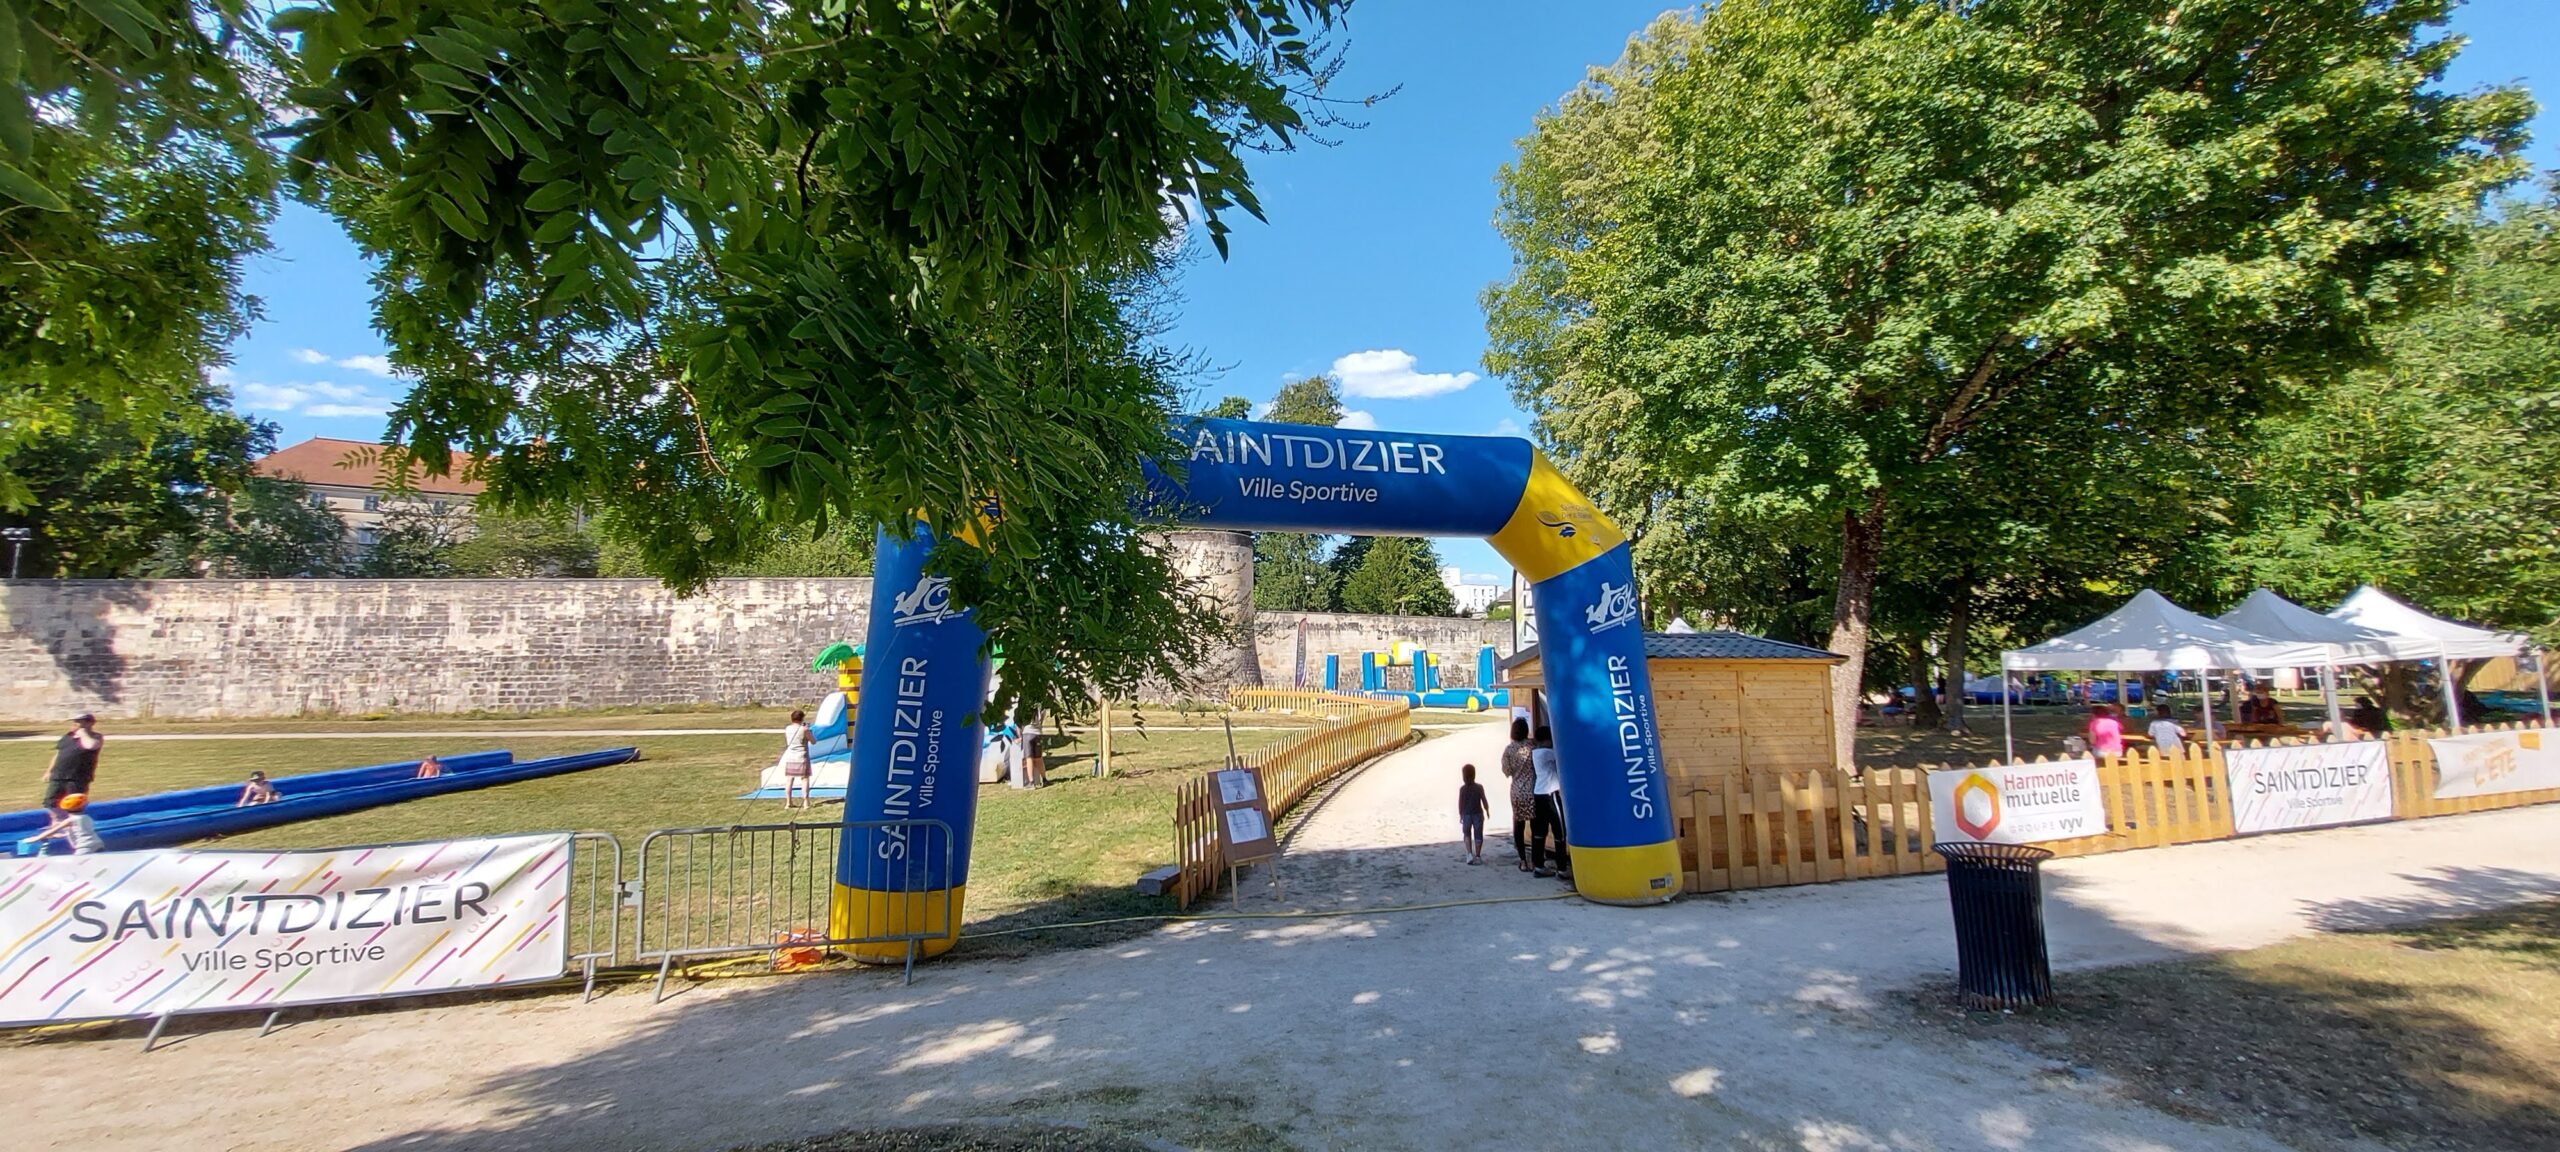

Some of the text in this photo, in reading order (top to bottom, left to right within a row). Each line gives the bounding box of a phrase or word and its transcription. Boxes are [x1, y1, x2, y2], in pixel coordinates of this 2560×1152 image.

[1239, 477, 1378, 504] Ville Sportive
[1638, 694, 1657, 774] Ville Sportive
[919, 710, 943, 808] Ville Sportive
[2004, 770, 2078, 791] Harmonie
[2006, 788, 2080, 808] mutuelle
[2287, 796, 2344, 809] Ville Sportive
[181, 942, 385, 973] Ville Sportive
